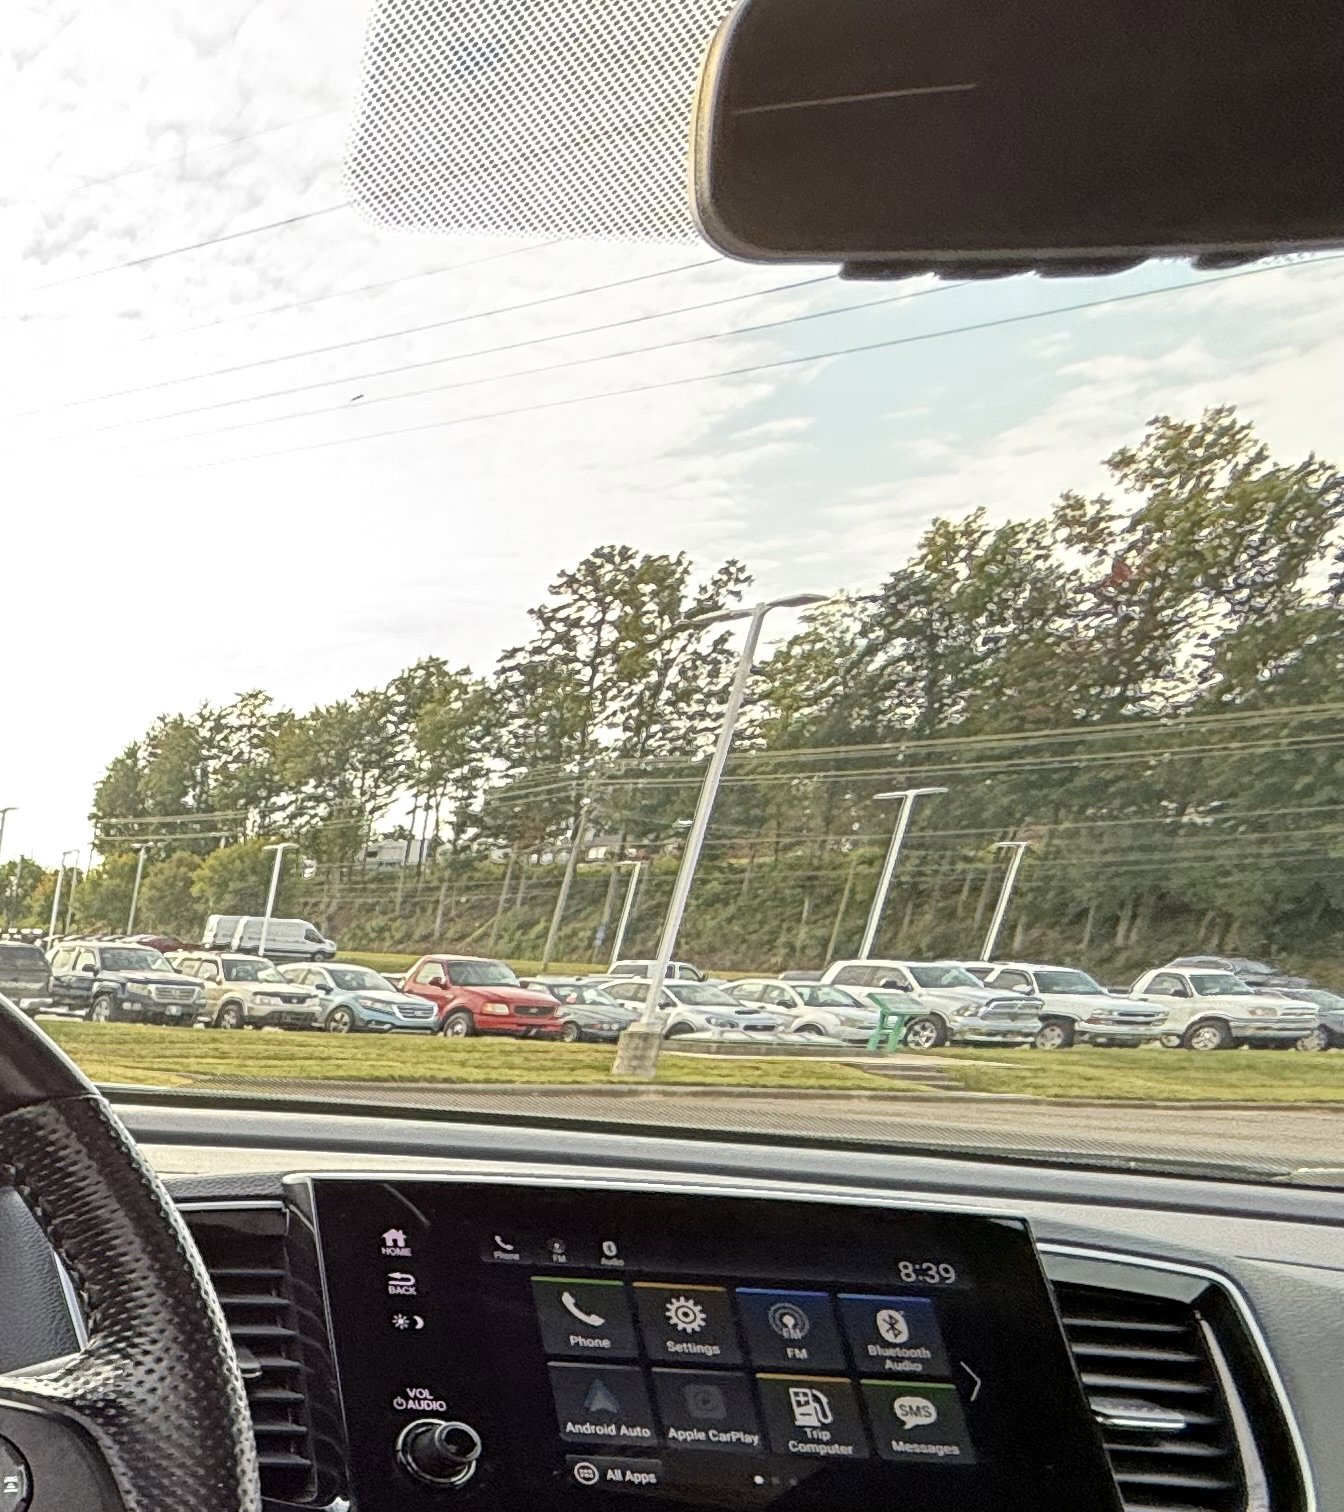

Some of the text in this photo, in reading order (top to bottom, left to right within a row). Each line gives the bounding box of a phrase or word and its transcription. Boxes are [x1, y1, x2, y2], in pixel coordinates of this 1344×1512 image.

[381, 1247, 412, 1257] HOME
[897, 1261, 957, 1284] 8:39
[388, 1285, 417, 1296] BACK
[569, 1335, 611, 1349] Phone
[667, 1341, 721, 1357] Settings
[786, 1347, 808, 1360] FM
[867, 1344, 931, 1359] Bluetooth
[884, 1359, 923, 1373] Audio
[407, 1387, 434, 1400] VOL
[406, 1399, 447, 1412] AUDIO
[898, 1403, 933, 1420] SMS
[566, 1421, 651, 1438] Android Auto
[668, 1427, 760, 1446] Apple CarPlay
[804, 1428, 831, 1441] Trip
[788, 1440, 853, 1456] Computer
[891, 1440, 960, 1456] Messages
[606, 1468, 657, 1484] All Apps
